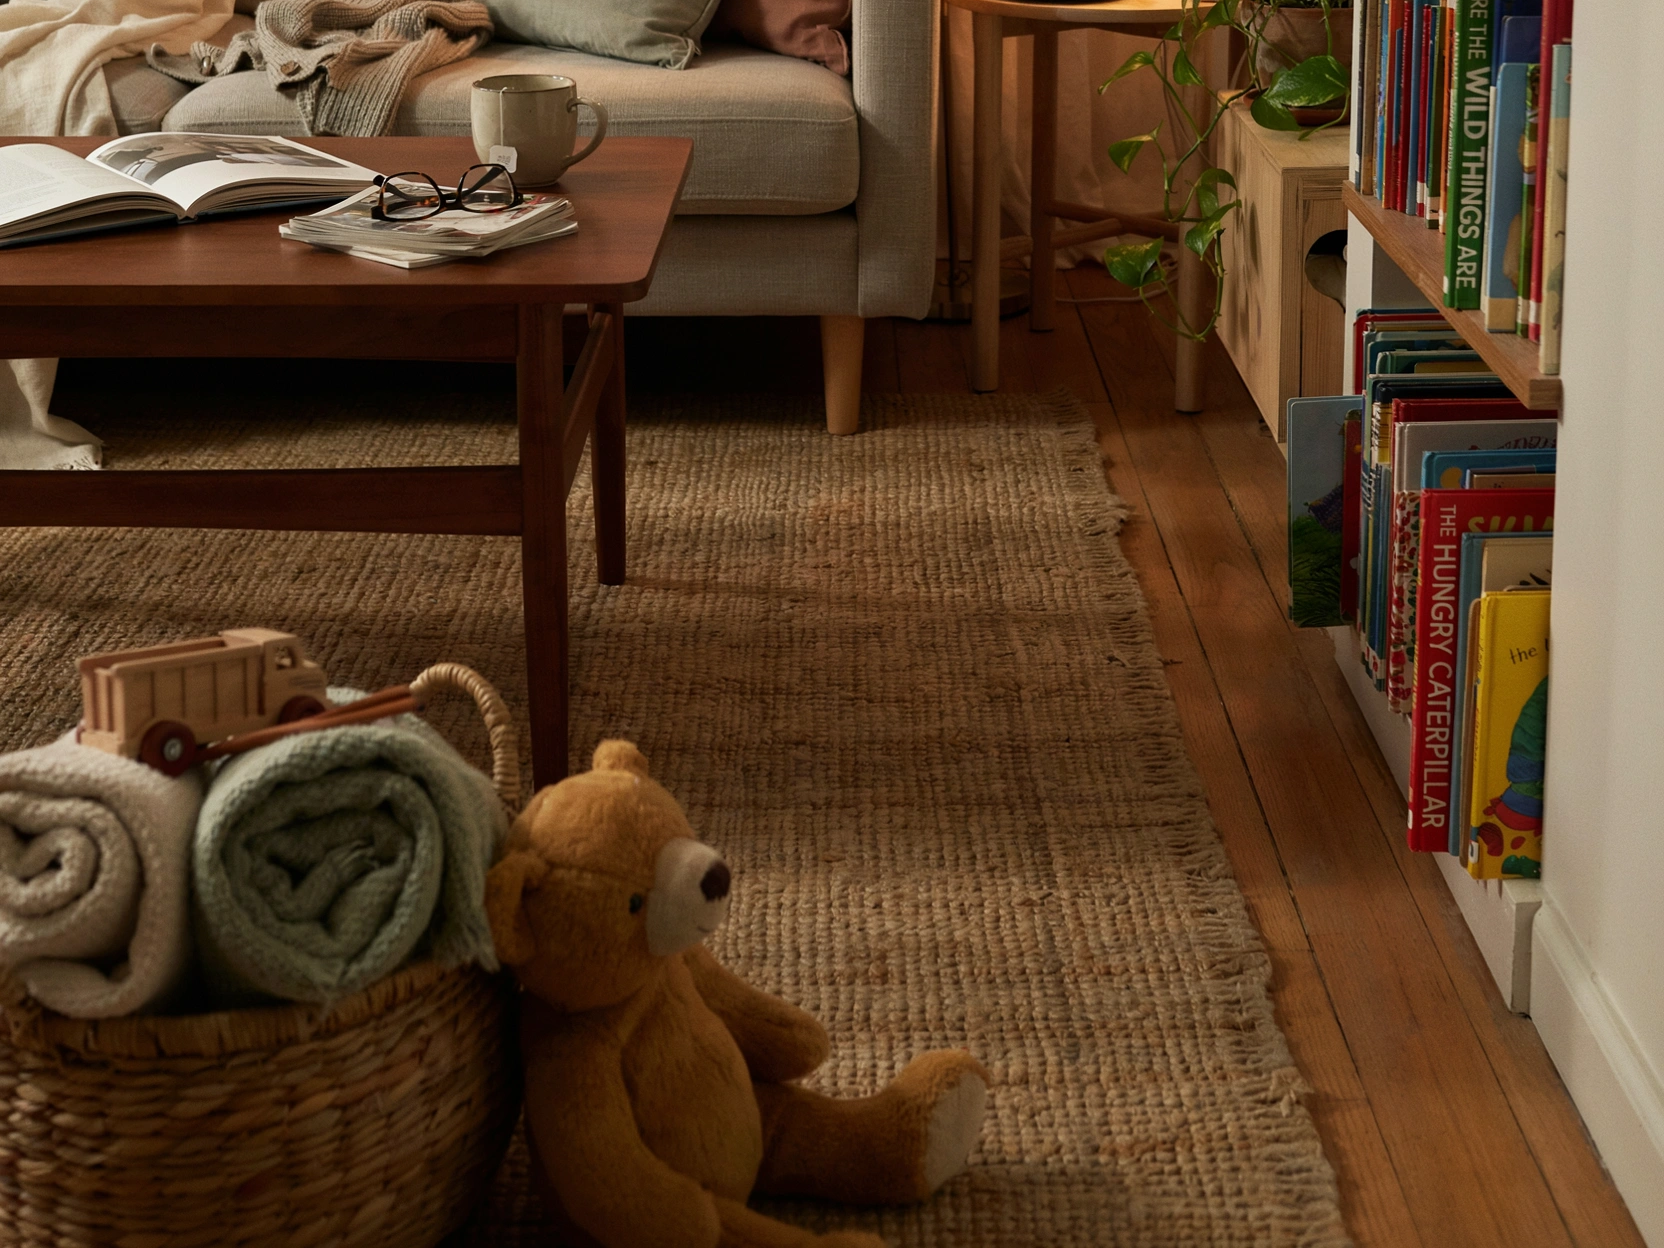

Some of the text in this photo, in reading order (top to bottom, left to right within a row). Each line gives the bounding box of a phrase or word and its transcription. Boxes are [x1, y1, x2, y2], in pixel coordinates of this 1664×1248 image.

[1467, 24, 1488, 60] THE
[1463, 67, 1491, 140] WILD
[1457, 146, 1486, 239] THINGS
[1456, 245, 1478, 290] ARE
[1421, 504, 1457, 828] THE HUNGRY CATERPILLAR
[1509, 646, 1539, 665] the
